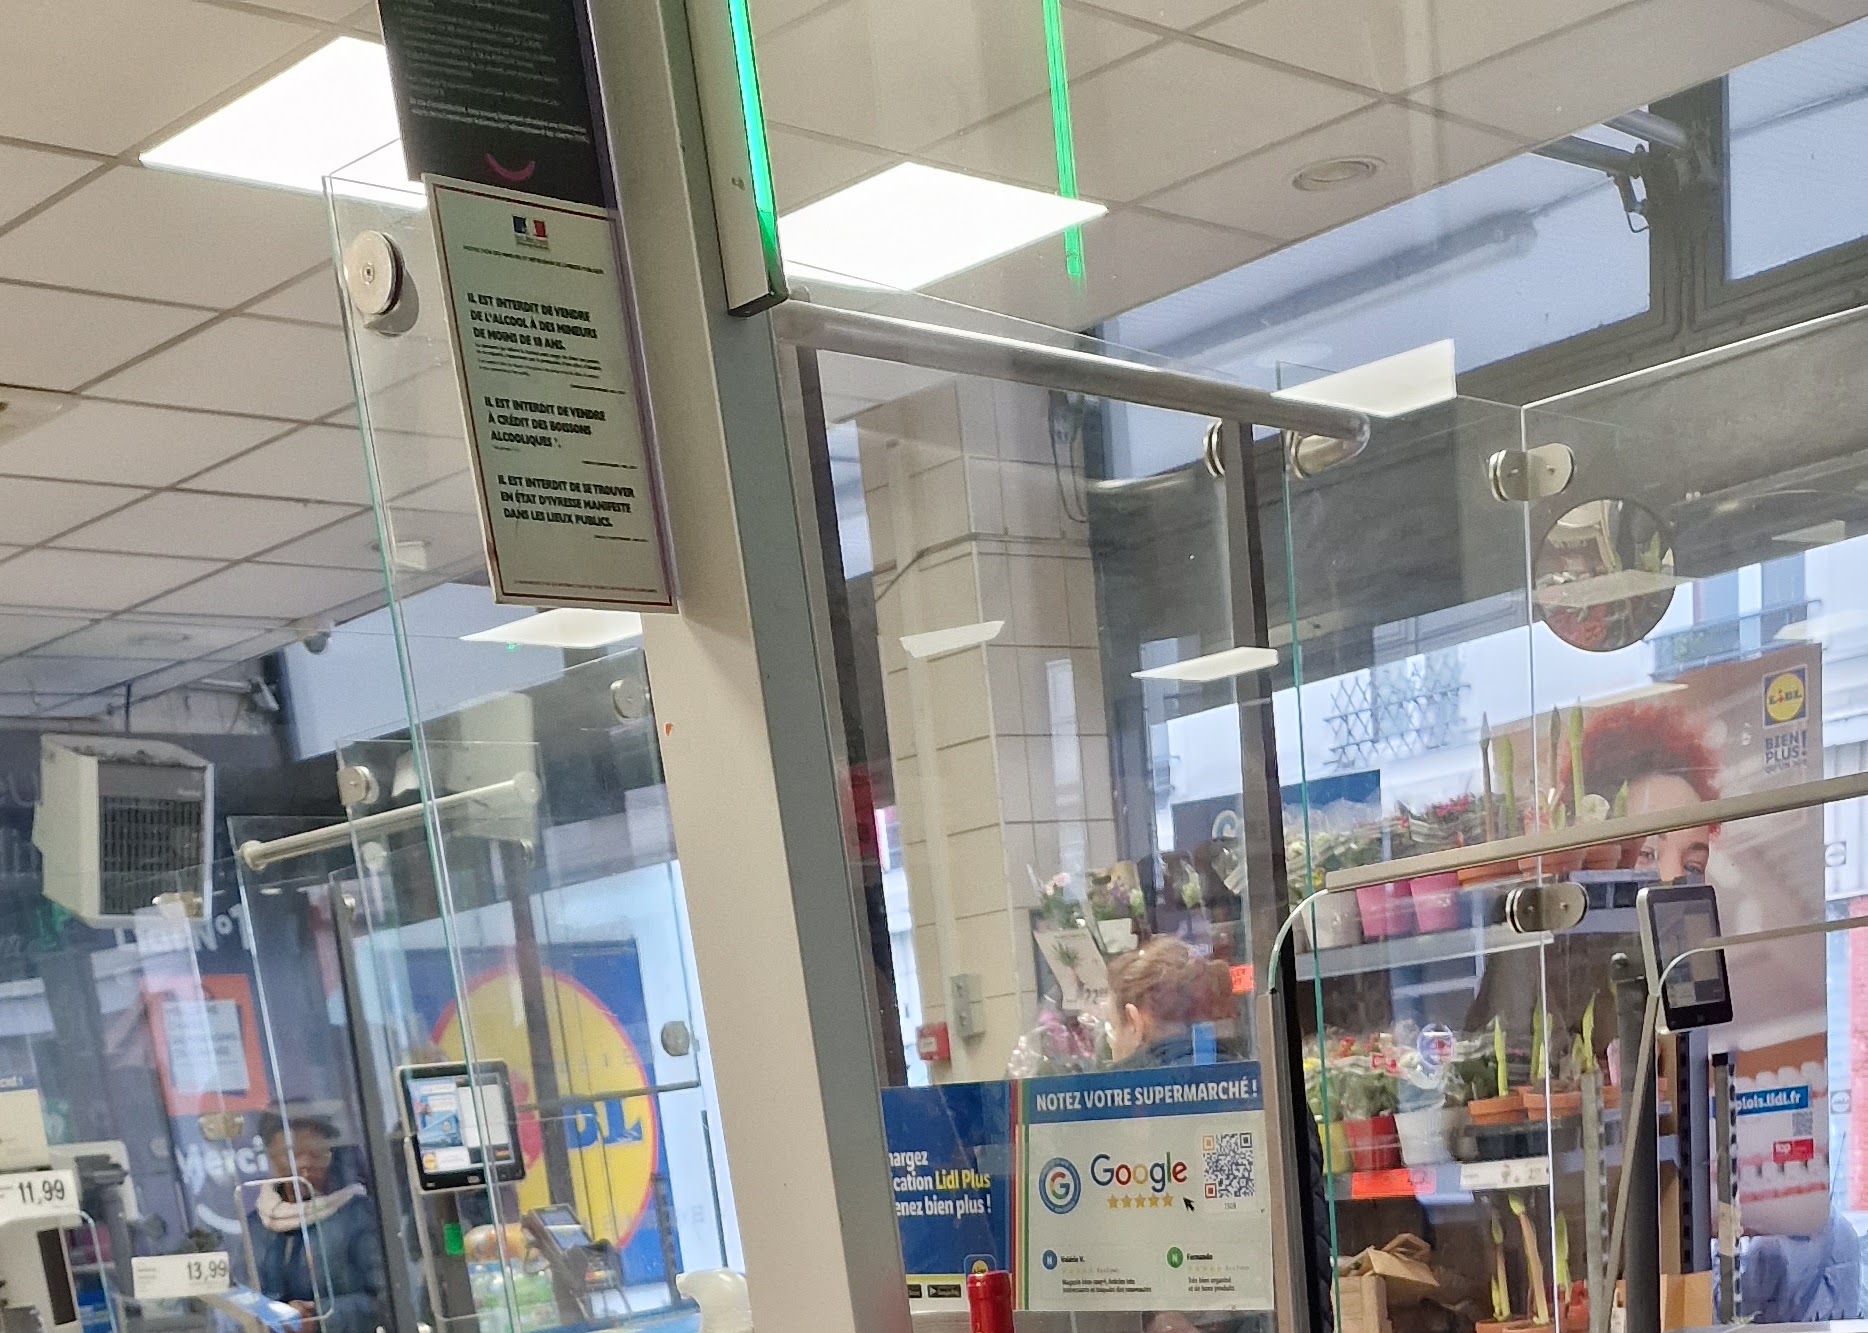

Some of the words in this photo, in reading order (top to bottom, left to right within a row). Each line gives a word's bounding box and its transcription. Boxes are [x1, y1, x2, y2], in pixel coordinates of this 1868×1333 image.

[467, 293, 476, 303] IL
[478, 294, 494, 306] EST
[495, 297, 539, 314] INTERDIT
[541, 304, 554, 316] DE
[554, 305, 590, 322] VENDRE
[470, 310, 483, 321] DE
[484, 312, 529, 328] L'ALCOOL
[538, 320, 555, 332] DES
[556, 322, 598, 339] MINEURS
[473, 327, 486, 339] DE
[487, 329, 518, 343] MOINS
[519, 333, 532, 345] DE
[484, 396, 493, 407] IL
[495, 397, 510, 409] EST
[513, 399, 555, 415] INTERDIT
[557, 405, 569, 416] DE
[568, 406, 606, 421] VENDRE
[488, 410, 496, 424] À
[497, 413, 529, 428] CRÉDIT
[531, 418, 548, 431] DES
[550, 420, 592, 435] BOISSONS
[498, 475, 505, 485] IL
[508, 475, 523, 487] EST
[525, 477, 568, 492] INTERDIT
[569, 481, 581, 493] DE
[582, 483, 592, 494] SE
[592, 484, 635, 498] TROUVER
[500, 490, 513, 502] EN
[515, 489, 536, 505] ÉTAT
[538, 494, 582, 509] D'IVRESSE
[583, 499, 631, 513] MANIFESTE
[503, 507, 529, 519] DANS
[531, 510, 545, 521] LES
[547, 512, 574, 524] LIEUX
[1765, 731, 1800, 750] BIEN
[1036, 1091, 1081, 1111] NOTEZ
[1084, 1087, 1131, 1107] VOTRE
[1134, 1078, 1249, 1105] SUPERMARCHÉ
[935, 1170, 958, 1189] Lidl
[962, 1170, 990, 1189] Plus
[1091, 1151, 1188, 1193] Google
[18, 1179, 65, 1204] 11,99
[925, 1196, 953, 1215] bien
[957, 1195, 984, 1219] plus
[187, 1260, 227, 1282] 13,99
